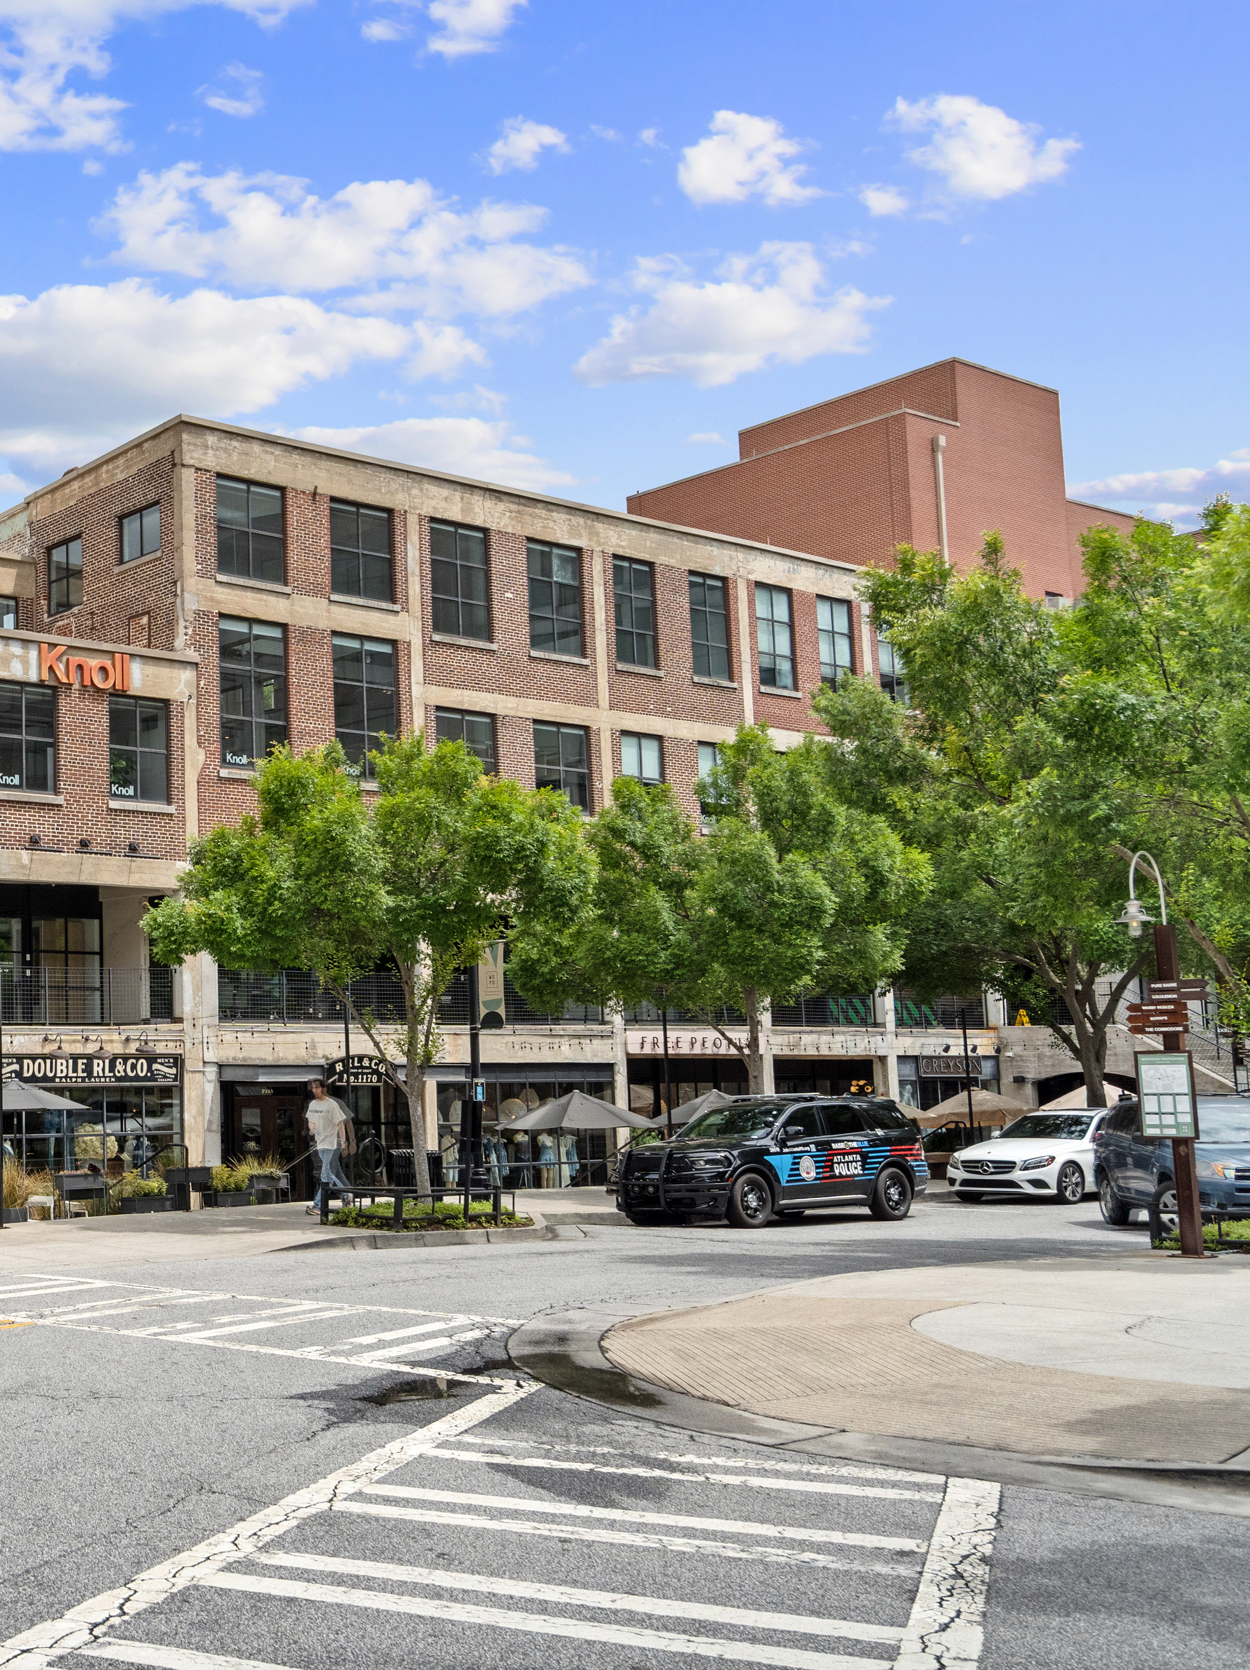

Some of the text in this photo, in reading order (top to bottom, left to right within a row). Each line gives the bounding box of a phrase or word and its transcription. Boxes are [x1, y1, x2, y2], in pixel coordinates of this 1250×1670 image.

[39, 643, 130, 691] Knoll
[226, 752, 247, 765] Knoll
[111, 783, 135, 796] Knoll
[641, 1036, 749, 1049] FREE PEOL
[23, 1058, 151, 1077] DOUBLE RL&CO.
[922, 1058, 981, 1073] GREYSON
[833, 1154, 861, 1163] ATLANTA
[833, 1162, 863, 1176] POLICE
